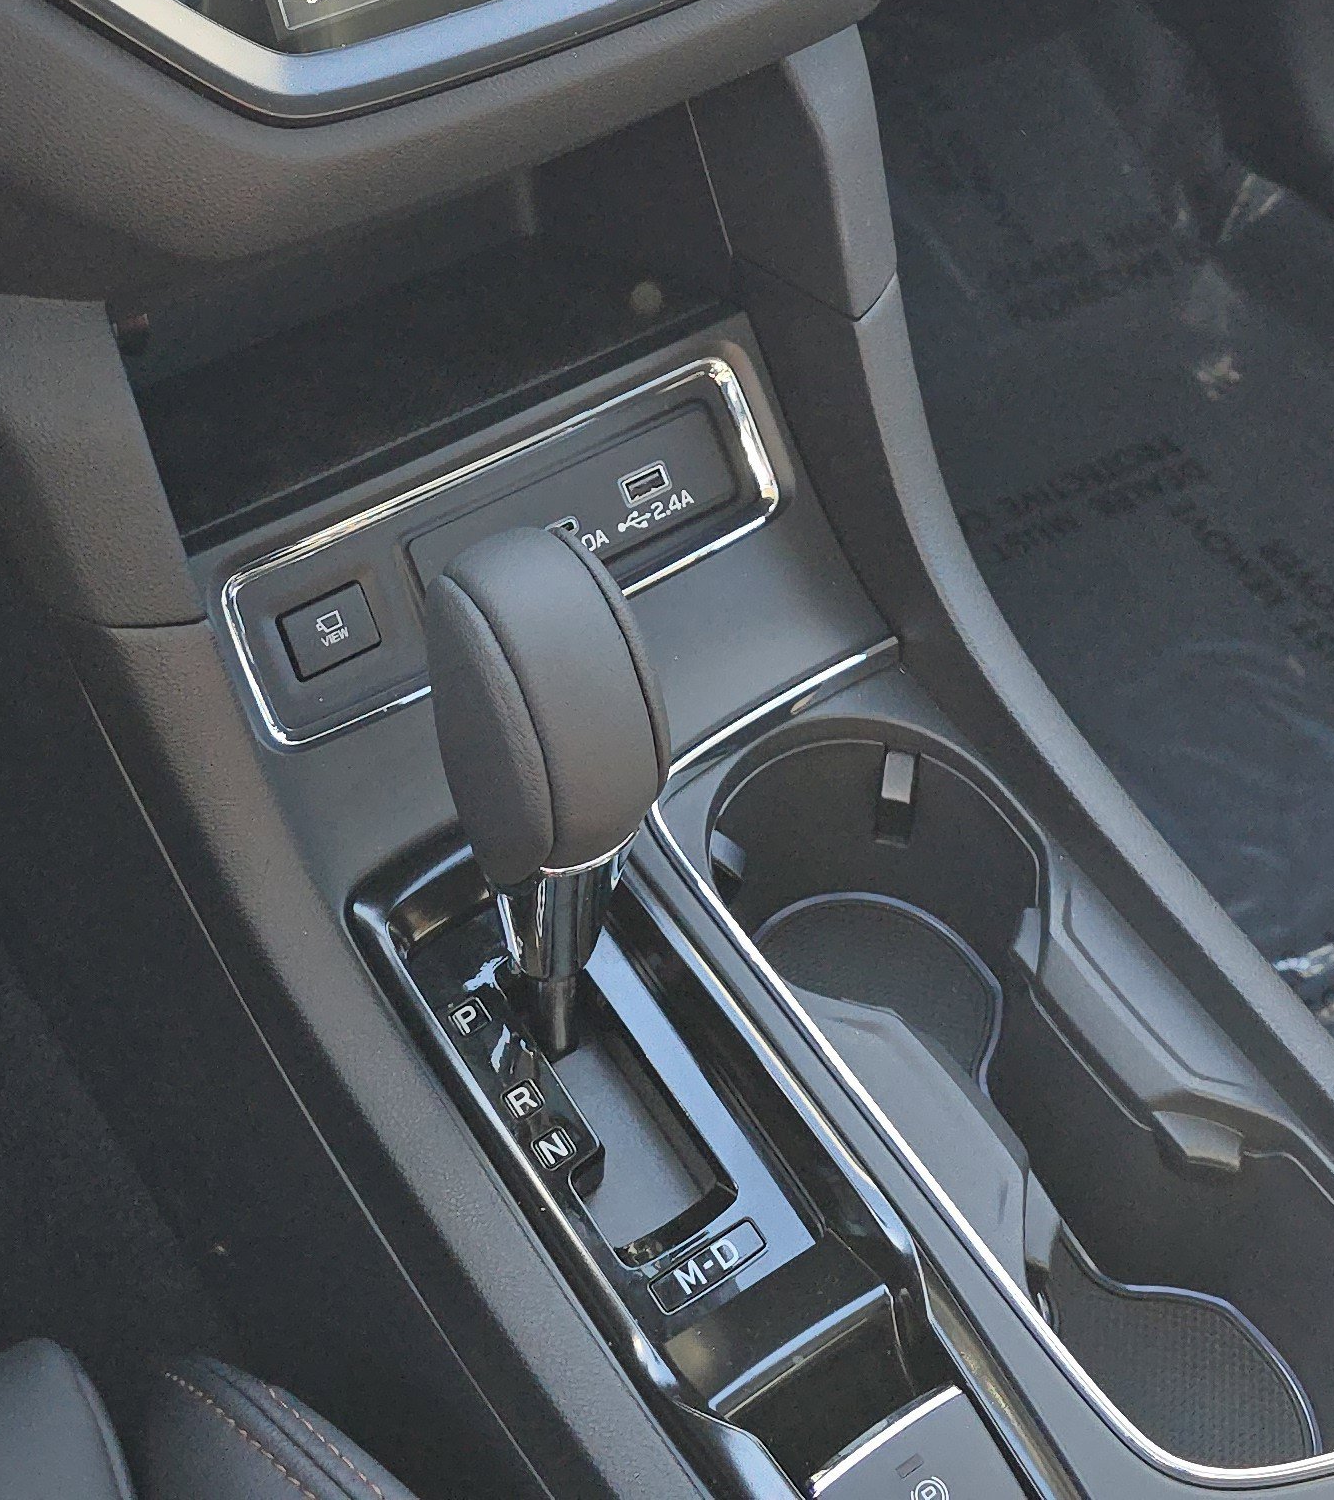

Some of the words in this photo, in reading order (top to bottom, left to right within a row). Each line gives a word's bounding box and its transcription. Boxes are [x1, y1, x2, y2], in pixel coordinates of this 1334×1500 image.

[650, 489, 695, 521] 2.4A
[320, 626, 350, 648] VIEW
[456, 1005, 478, 1035] P
[509, 1086, 537, 1115] R
[540, 1134, 568, 1164] N
